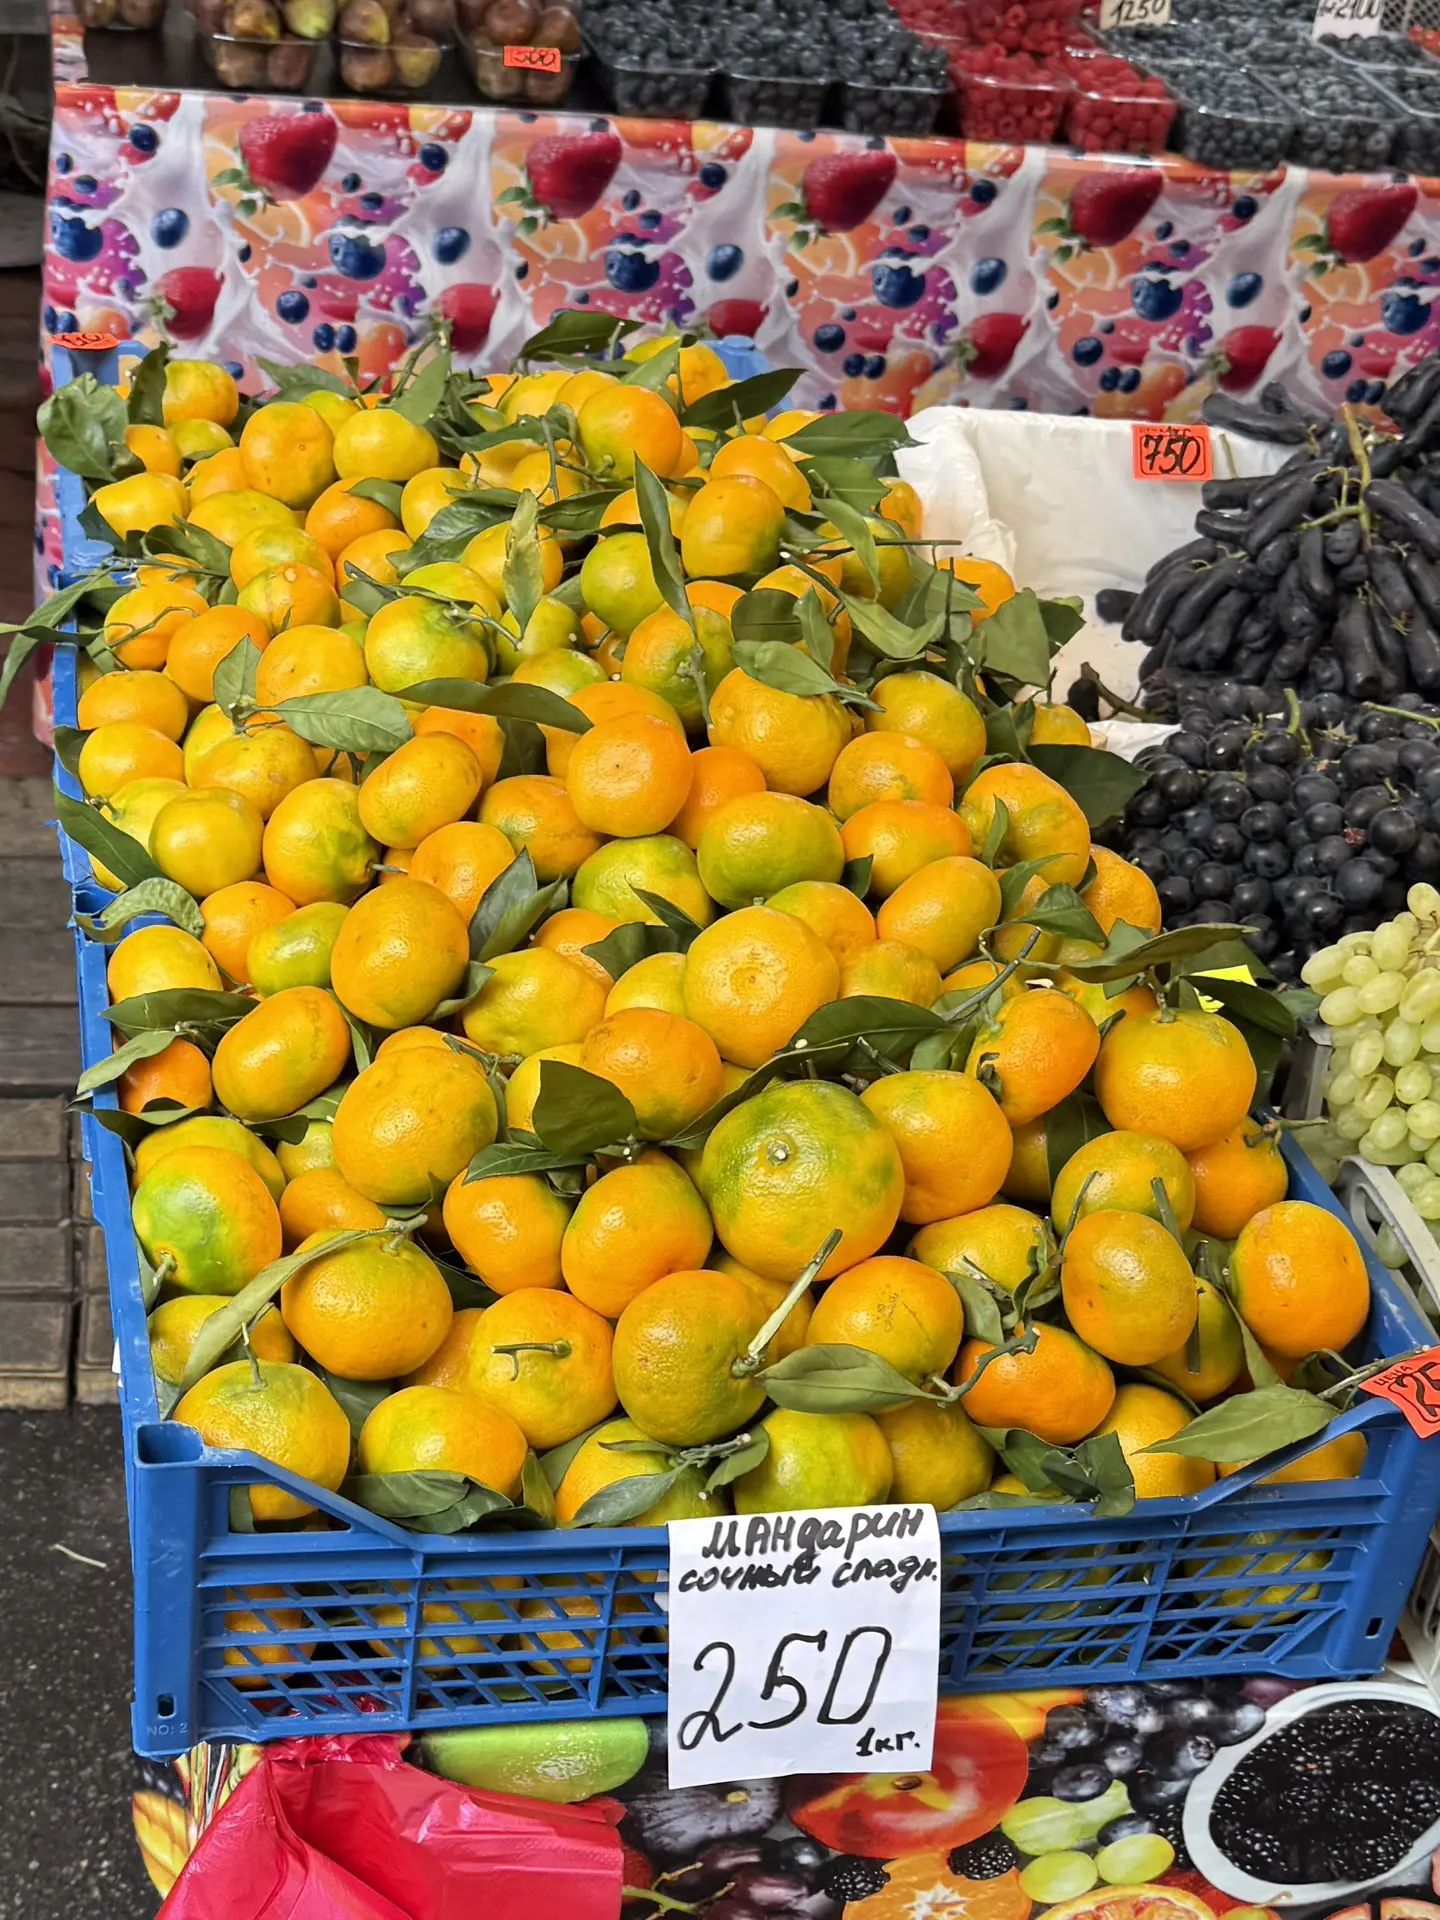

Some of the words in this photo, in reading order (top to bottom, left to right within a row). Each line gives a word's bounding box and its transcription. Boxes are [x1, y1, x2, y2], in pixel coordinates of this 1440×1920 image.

[1143, 433, 1201, 475] 750
[1373, 1365, 1413, 1386] ЦЕНА
[676, 1625, 893, 1751] 250
